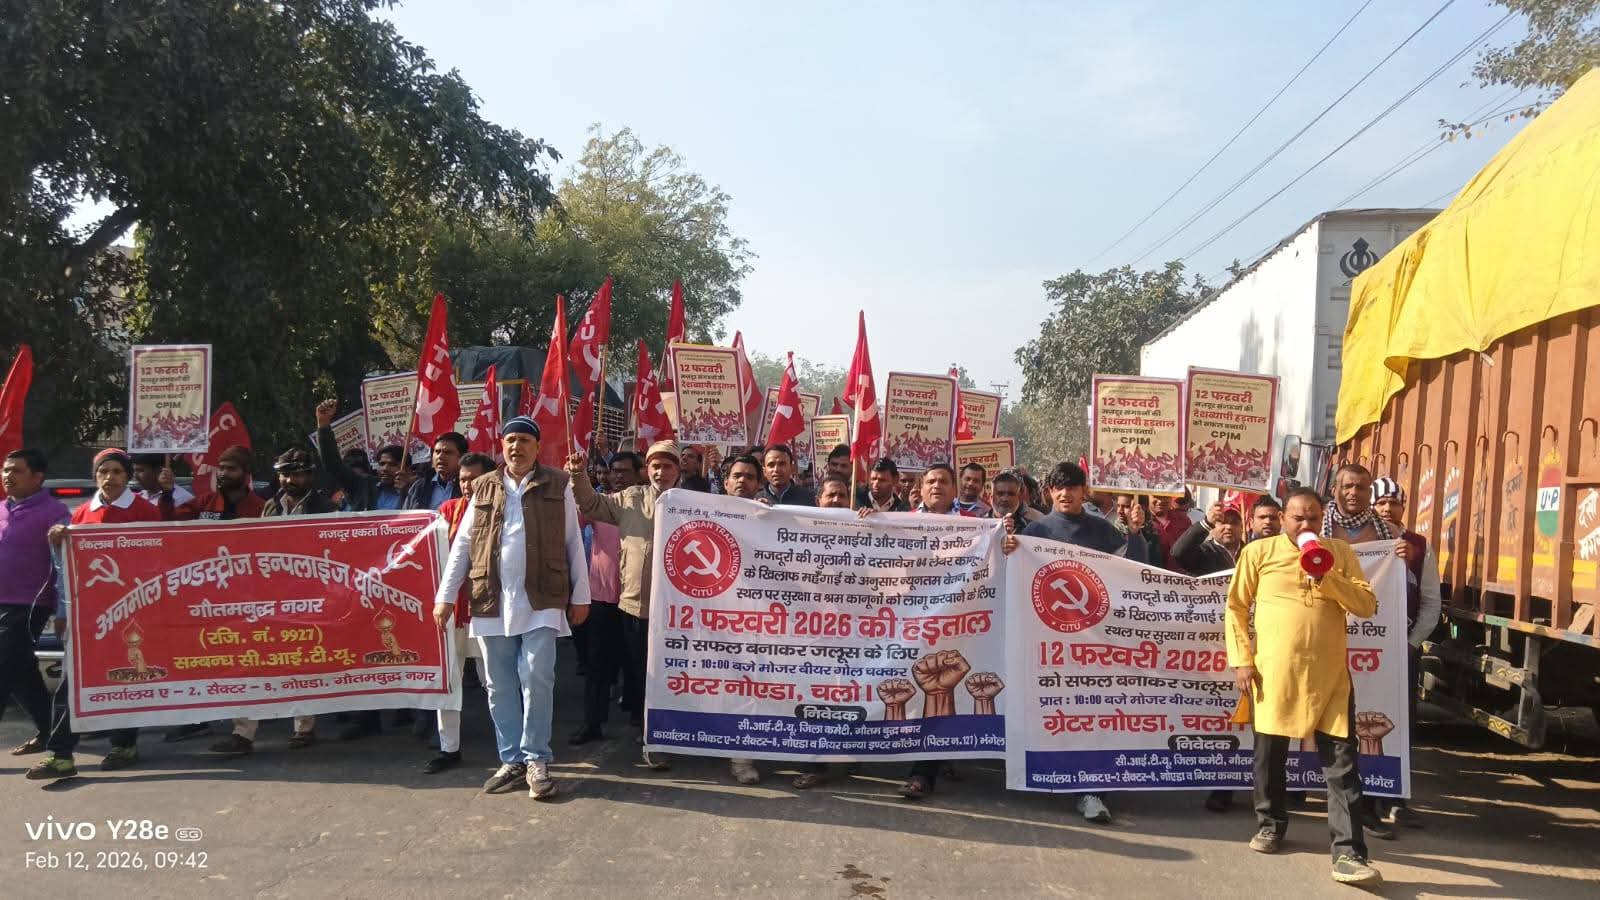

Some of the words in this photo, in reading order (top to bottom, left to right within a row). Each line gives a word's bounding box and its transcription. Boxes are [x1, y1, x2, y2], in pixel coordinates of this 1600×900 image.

[680, 364, 690, 372] 12
[368, 394, 378, 402] 12
[1102, 397, 1116, 406] 12
[1118, 396, 1159, 408] फरवरी
[1195, 390, 1208, 399] 12
[1211, 391, 1252, 403] फरवरी
[385, 420, 407, 428] CPIM
[1120, 436, 1150, 445] CPIM
[1211, 431, 1240, 440] CPIM
[319, 530, 350, 542] मजदूर
[352, 528, 377, 538] एकता
[777, 528, 798, 544] प्रिय
[800, 533, 837, 550] मजदूर
[838, 532, 872, 548] भाईयों
[874, 534, 896, 548] और
[897, 536, 928, 550] बहनों
[930, 537, 940, 550] से
[942, 536, 972, 550] अपील
[666, 542, 676, 576] CENTRE
[672, 530, 682, 541] OF
[683, 520, 713, 534] INDIAN
[715, 525, 739, 548] TRADE
[728, 552, 740, 580] UNION
[754, 548, 793, 566] मजदूरों
[796, 549, 812, 563] की
[814, 551, 851, 570] गुलामी
[854, 553, 866, 566] के
[868, 555, 914, 568] दस्तावेज
[744, 565, 756, 578] के
[759, 565, 800, 582] खिलाफ
[802, 570, 842, 586] महँगाई
[844, 572, 857, 584] के
[858, 576, 898, 591] अनुसार
[900, 576, 942, 590] न्यूनतम
[1141, 569, 1161, 588] प्रिय
[1163, 574, 1200, 590] मजदूर
[95, 576, 163, 640] अनमोल
[166, 546, 253, 596] इण्डस्ट्रीज
[354, 567, 424, 622] यूनियन
[691, 588, 713, 597] CITU
[1034, 580, 1044, 614] CENTRE
[1049, 560, 1078, 571] INDIAN
[1081, 565, 1104, 589] TRADE
[1096, 591, 1108, 617] UNION
[736, 588, 762, 600] स्थल
[765, 589, 780, 601] पर
[782, 590, 810, 606] सुरक्षा
[813, 592, 822, 602] व
[824, 592, 844, 603] श्रम
[846, 592, 884, 610] कानूनों
[886, 592, 902, 606] को
[903, 595, 928, 610] लागू
[978, 586, 996, 599] लिए
[1122, 590, 1160, 607] मजदूरों
[1164, 591, 1182, 604] की
[1182, 590, 1220, 608] गुलामी
[188, 599, 276, 623] गौतमबुद्ध
[281, 598, 324, 614] नगर
[1114, 606, 1126, 619] के
[1129, 606, 1172, 622] खिलाफ
[668, 604, 694, 629] 12
[701, 602, 789, 634] फरवरी
[794, 611, 852, 637] 2026
[858, 607, 898, 638] की
[902, 610, 994, 646] हड़ताल
[1060, 623, 1080, 632] CITU
[253, 627, 275, 642] नं.
[281, 624, 324, 644] 9927)
[1105, 625, 1132, 639] स्थल
[1135, 628, 1152, 640] पर
[1152, 629, 1184, 646] सुरक्षा
[1187, 632, 1196, 642] व
[1199, 631, 1220, 642] श्रम
[1346, 622, 1359, 636] के
[1362, 621, 1387, 637] लिए
[665, 635, 689, 650] को
[692, 639, 744, 654] सफल
[746, 642, 808, 656] बनाकर
[810, 645, 860, 664] जलूस
[864, 644, 884, 660] के
[887, 644, 920, 660] लिए
[1040, 641, 1064, 666] 12
[1070, 640, 1160, 669] फरवरी
[1166, 650, 1227, 672] 2026
[174, 654, 234, 669] सम्बन्ध
[664, 657, 688, 668] प्रात
[702, 658, 730, 670] 10:00
[732, 660, 756, 672] बजे
[758, 661, 797, 674] मोजर
[800, 662, 830, 675] बीयर
[834, 665, 864, 676] गोल
[866, 666, 908, 677] चक्कर
[88, 688, 154, 703] कार्यालय
[158, 688, 168, 699] ए
[207, 682, 246, 695] सैक्टर
[334, 672, 402, 685] गौतमबुद्ध
[406, 671, 436, 682] नगर
[667, 672, 722, 696] ग्रेटर
[724, 675, 803, 702] नोएडा,
[1038, 672, 1061, 688] को
[1064, 675, 1114, 688] सफल
[1116, 675, 1180, 689] बनाकर
[1182, 680, 1236, 696] जलूस
[1040, 696, 1062, 708] प्रात
[1074, 694, 1102, 706] 10:00
[1104, 693, 1126, 706] बजे
[1130, 693, 1167, 706] मोजर
[1206, 696, 1237, 708] गोल
[803, 705, 860, 721] निवेदक
[1044, 709, 1095, 736] ग्रेटर
[1099, 708, 1174, 733] नोएडा,
[653, 729, 690, 742] कार्यालय
[698, 732, 723, 744] निकट
[800, 722, 824, 734] जिला
[854, 724, 881, 735] गौतम
[883, 726, 898, 738] बुद्ध
[1176, 736, 1232, 750] निवेदक
[1174, 754, 1196, 766] जिला
[1032, 771, 1072, 784] कार्यालय
[1364, 776, 1395, 788] भंगेल
